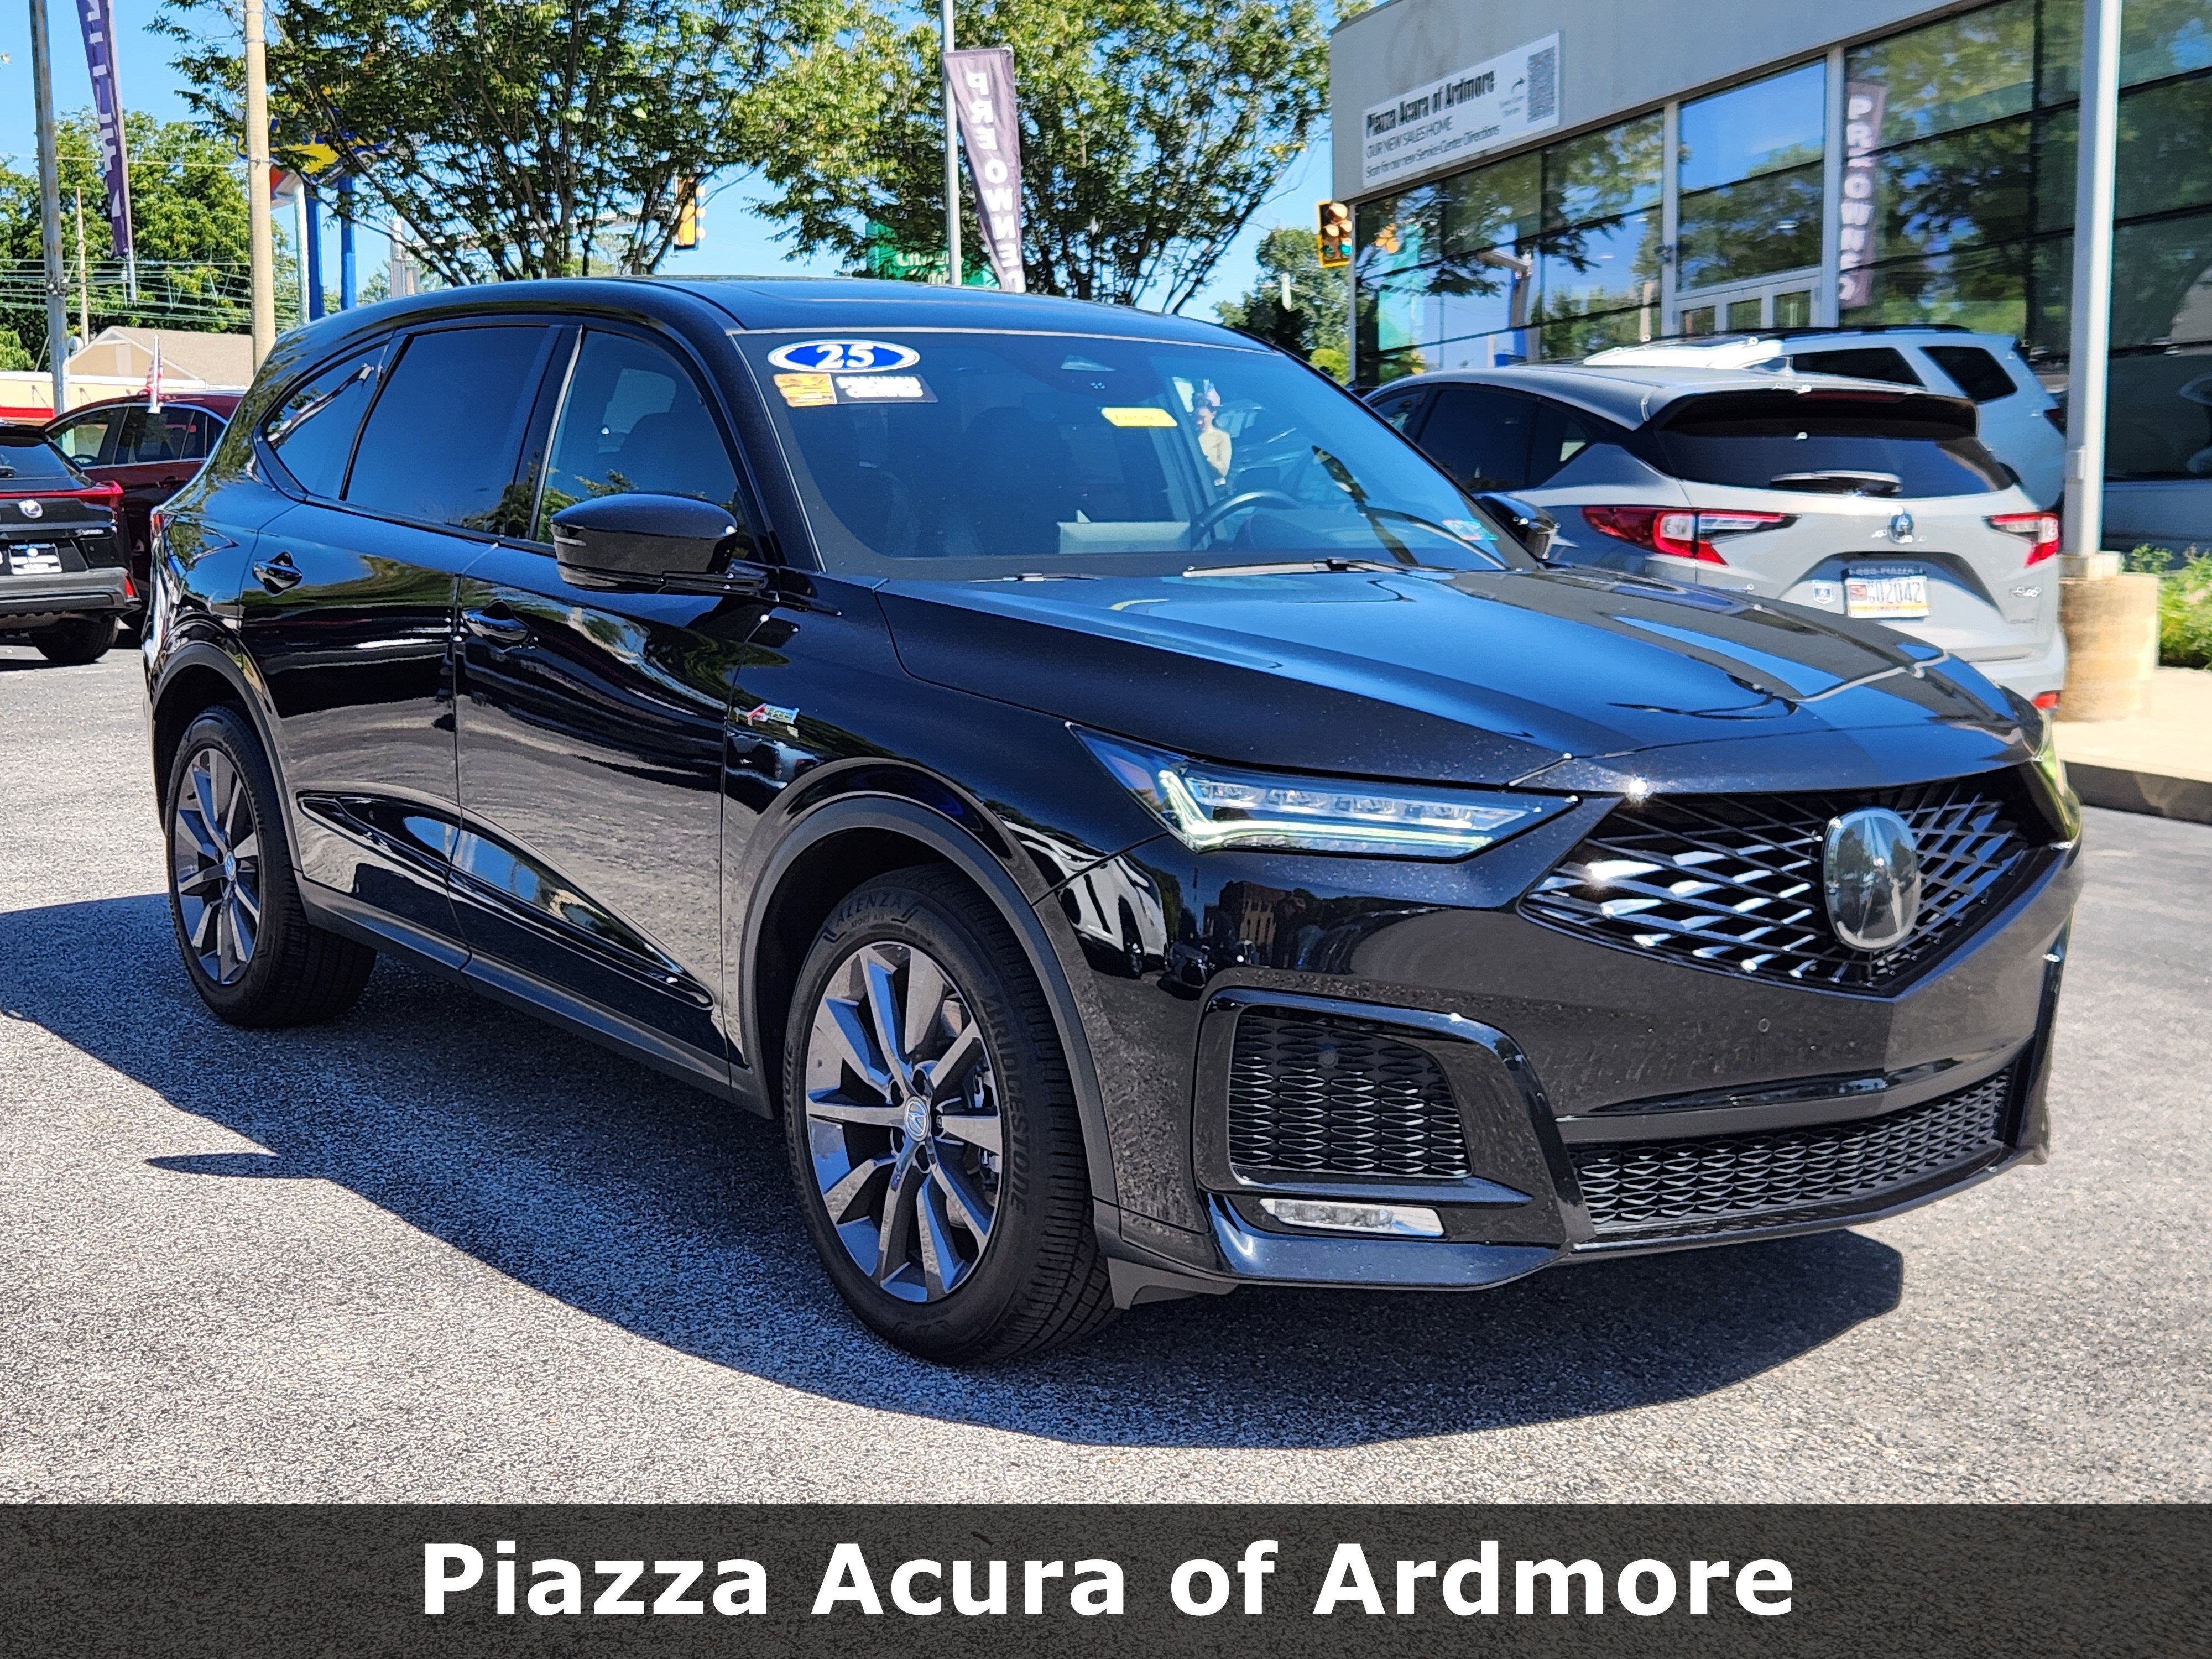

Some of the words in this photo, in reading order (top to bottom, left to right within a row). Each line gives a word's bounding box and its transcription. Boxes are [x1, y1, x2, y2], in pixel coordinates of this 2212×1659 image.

[1399, 96, 1430, 126] Acura
[1432, 86, 1444, 114] of
[1445, 71, 1495, 109] Ardmore
[1366, 142, 1383, 159] OUR
[1383, 135, 1401, 154] NEW
[1402, 126, 1425, 147] SALES
[1426, 116, 1453, 138] HOME
[815, 343, 875, 369] 25
[837, 893, 902, 926] ALENZA
